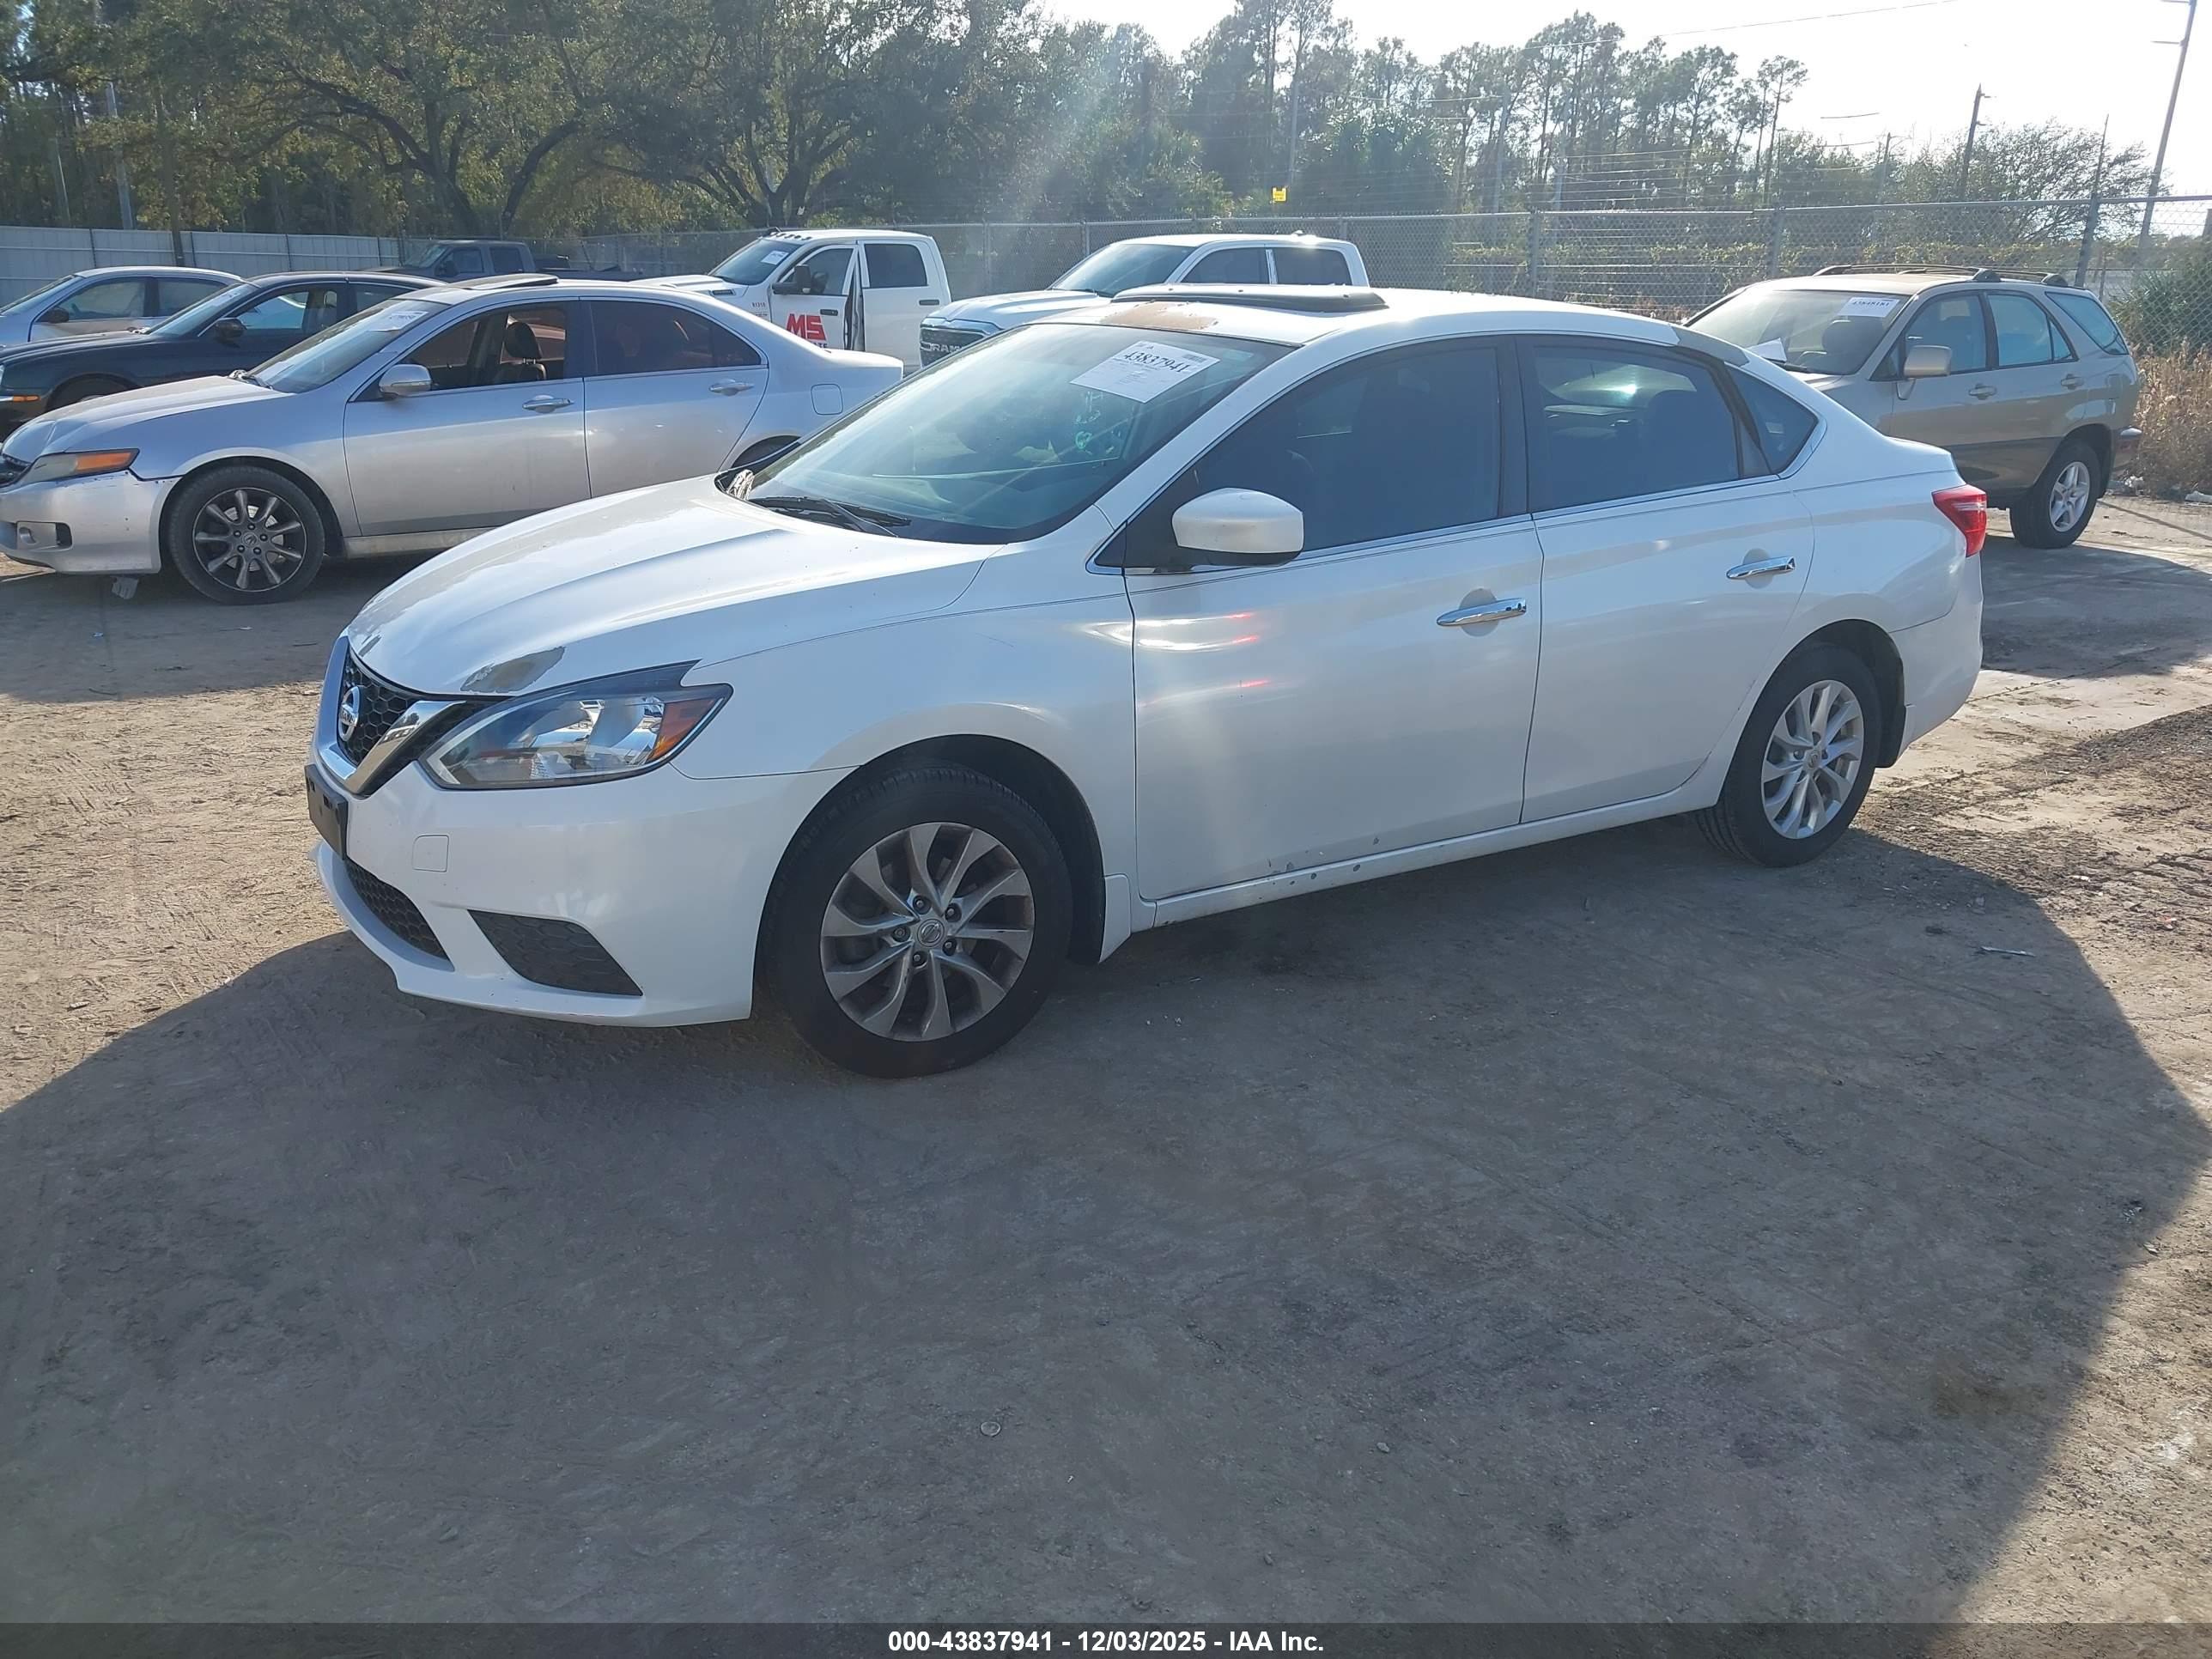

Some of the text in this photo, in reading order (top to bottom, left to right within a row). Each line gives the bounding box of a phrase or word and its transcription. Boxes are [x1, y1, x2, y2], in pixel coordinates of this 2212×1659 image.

[786, 313, 826, 340] MS
[933, 343, 960, 353] RAM
[1124, 351, 1191, 373] 43837941
